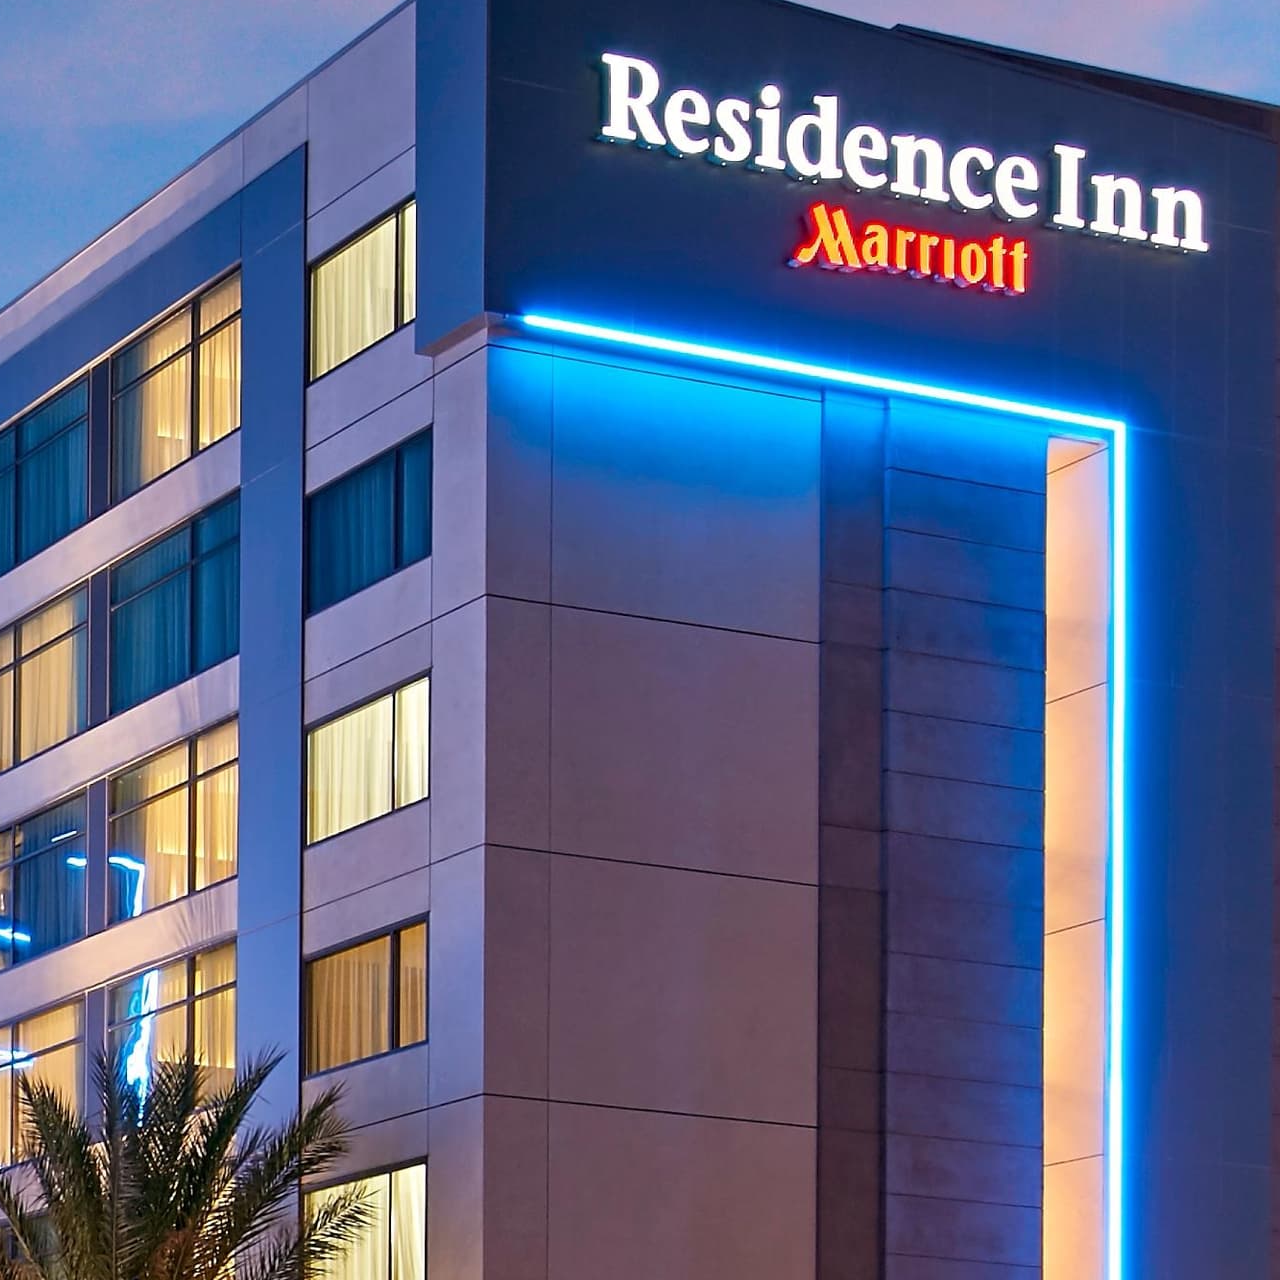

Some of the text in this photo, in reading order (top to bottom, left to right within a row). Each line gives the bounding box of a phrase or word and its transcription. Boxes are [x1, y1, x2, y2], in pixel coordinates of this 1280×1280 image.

[600, 52, 1209, 253] Residence Inn
[795, 203, 1029, 294] Marriott
